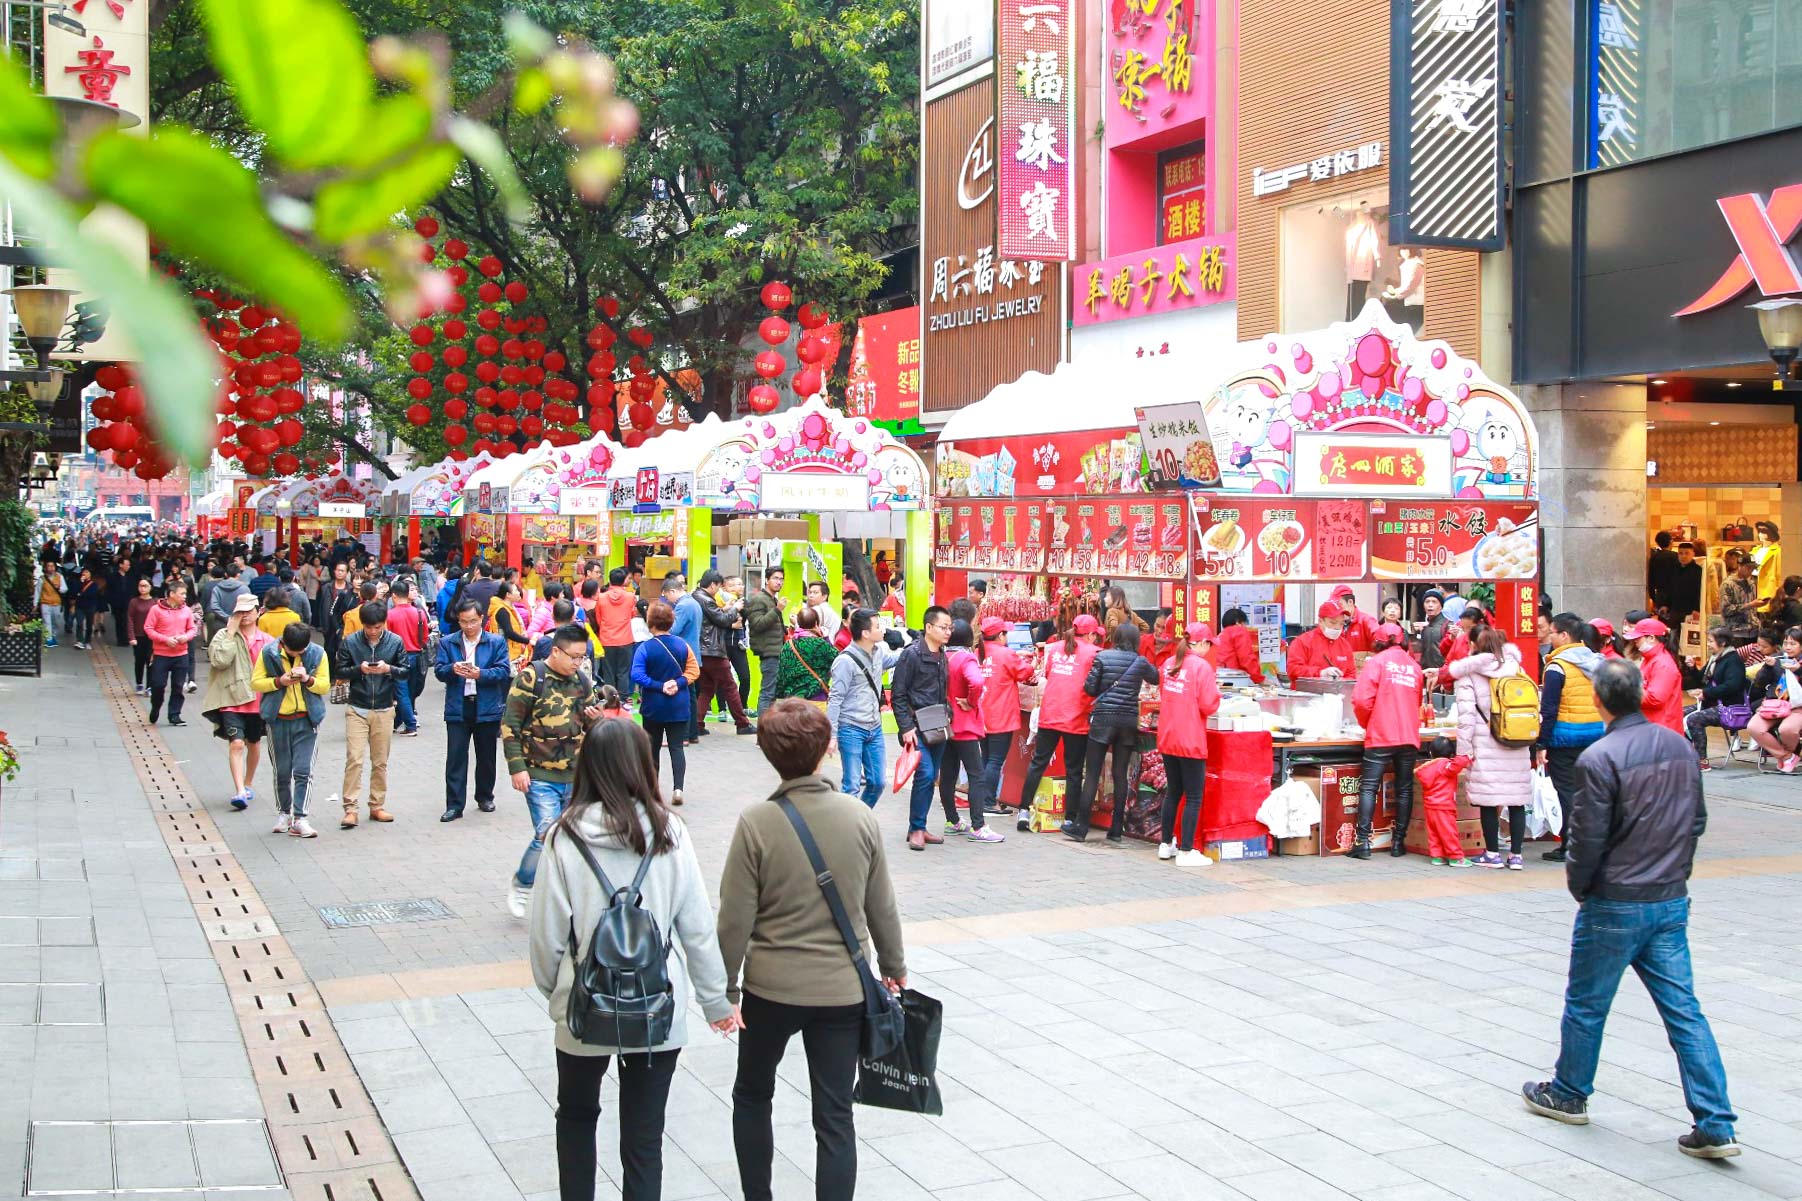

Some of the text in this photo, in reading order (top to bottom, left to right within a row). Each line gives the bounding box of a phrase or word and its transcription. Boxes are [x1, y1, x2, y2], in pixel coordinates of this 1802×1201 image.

[1310, 142, 1382, 182] 爱依服
[1168, 200, 1205, 239] 酒楼
[1084, 245, 1225, 316] 羊蝎子火锅
[930, 295, 1043, 332] ZHOU LIU FU JEWELRY
[1155, 447, 1180, 481] 10
[1438, 509, 1488, 538] 水饺
[1134, 551, 1149, 575] 42
[1265, 550, 1291, 576] 10
[1416, 537, 1448, 567] 5.0
[1175, 588, 1185, 639] 收银处
[1521, 586, 1534, 634] 收银处
[882, 1078, 910, 1093] Jeans
